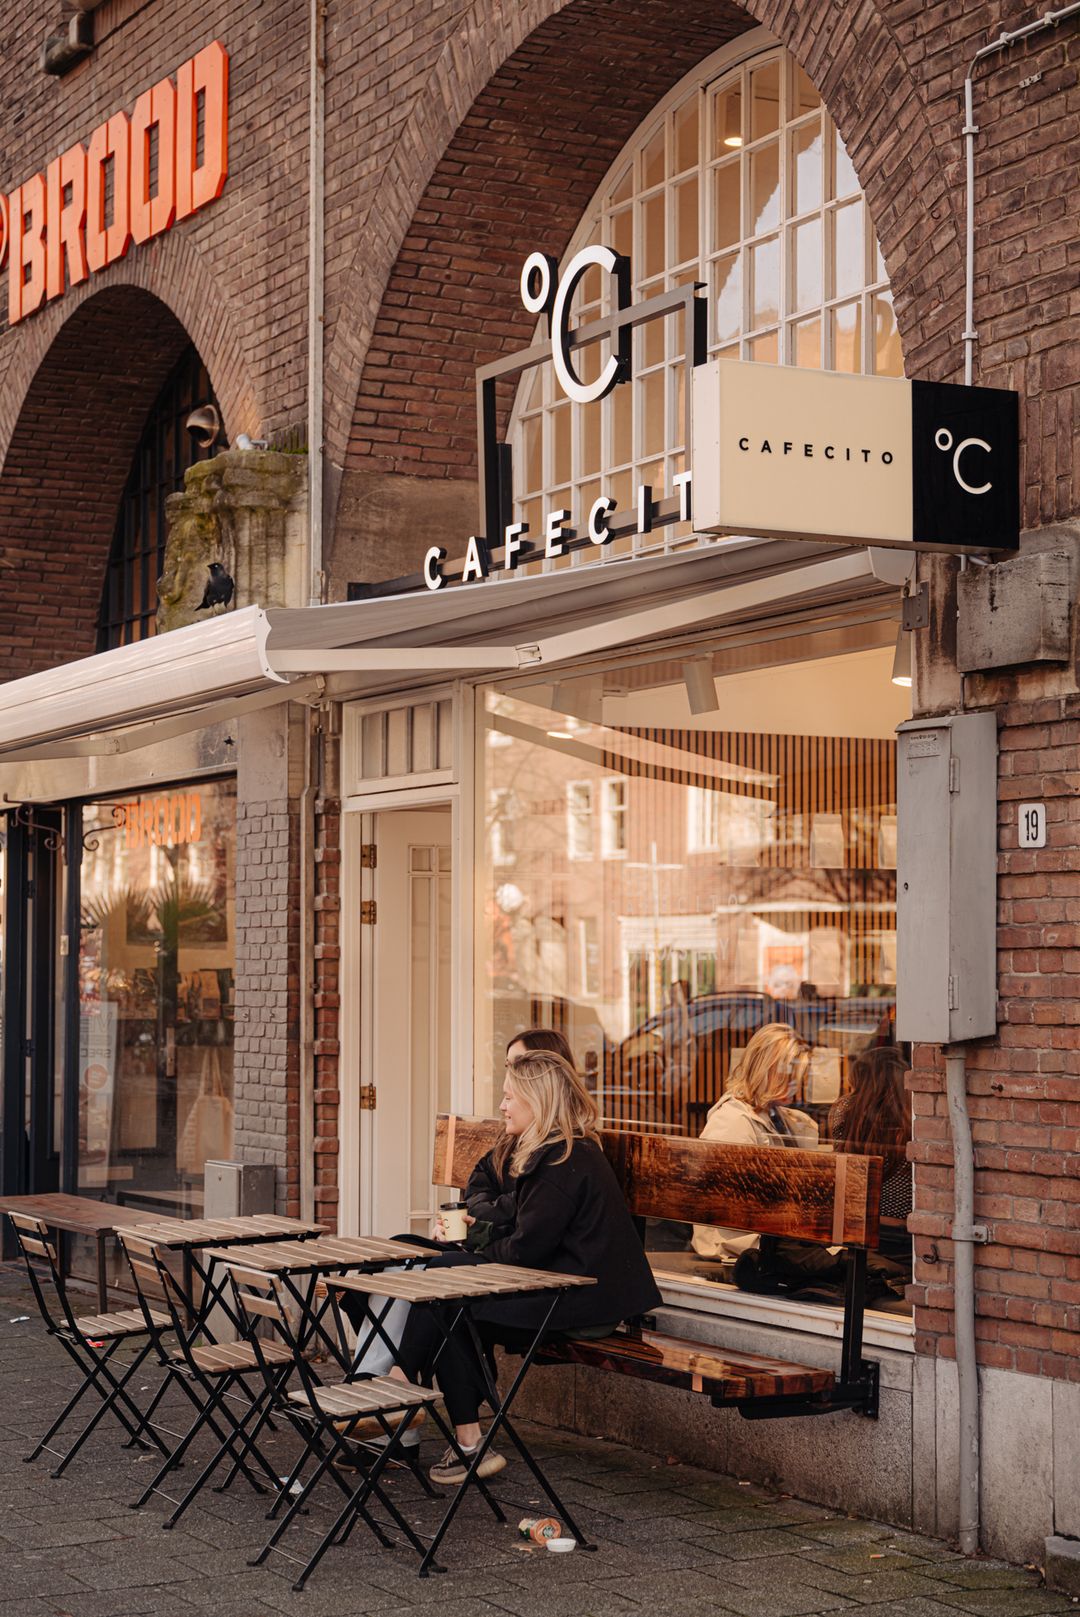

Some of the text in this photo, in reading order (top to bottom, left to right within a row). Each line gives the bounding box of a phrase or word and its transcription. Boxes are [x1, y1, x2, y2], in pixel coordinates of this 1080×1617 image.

[8, 39, 229, 326] BROOD
[738, 436, 894, 465] CAFECITO
[125, 793, 201, 849] BROOD
[1025, 809, 1039, 841] 19
